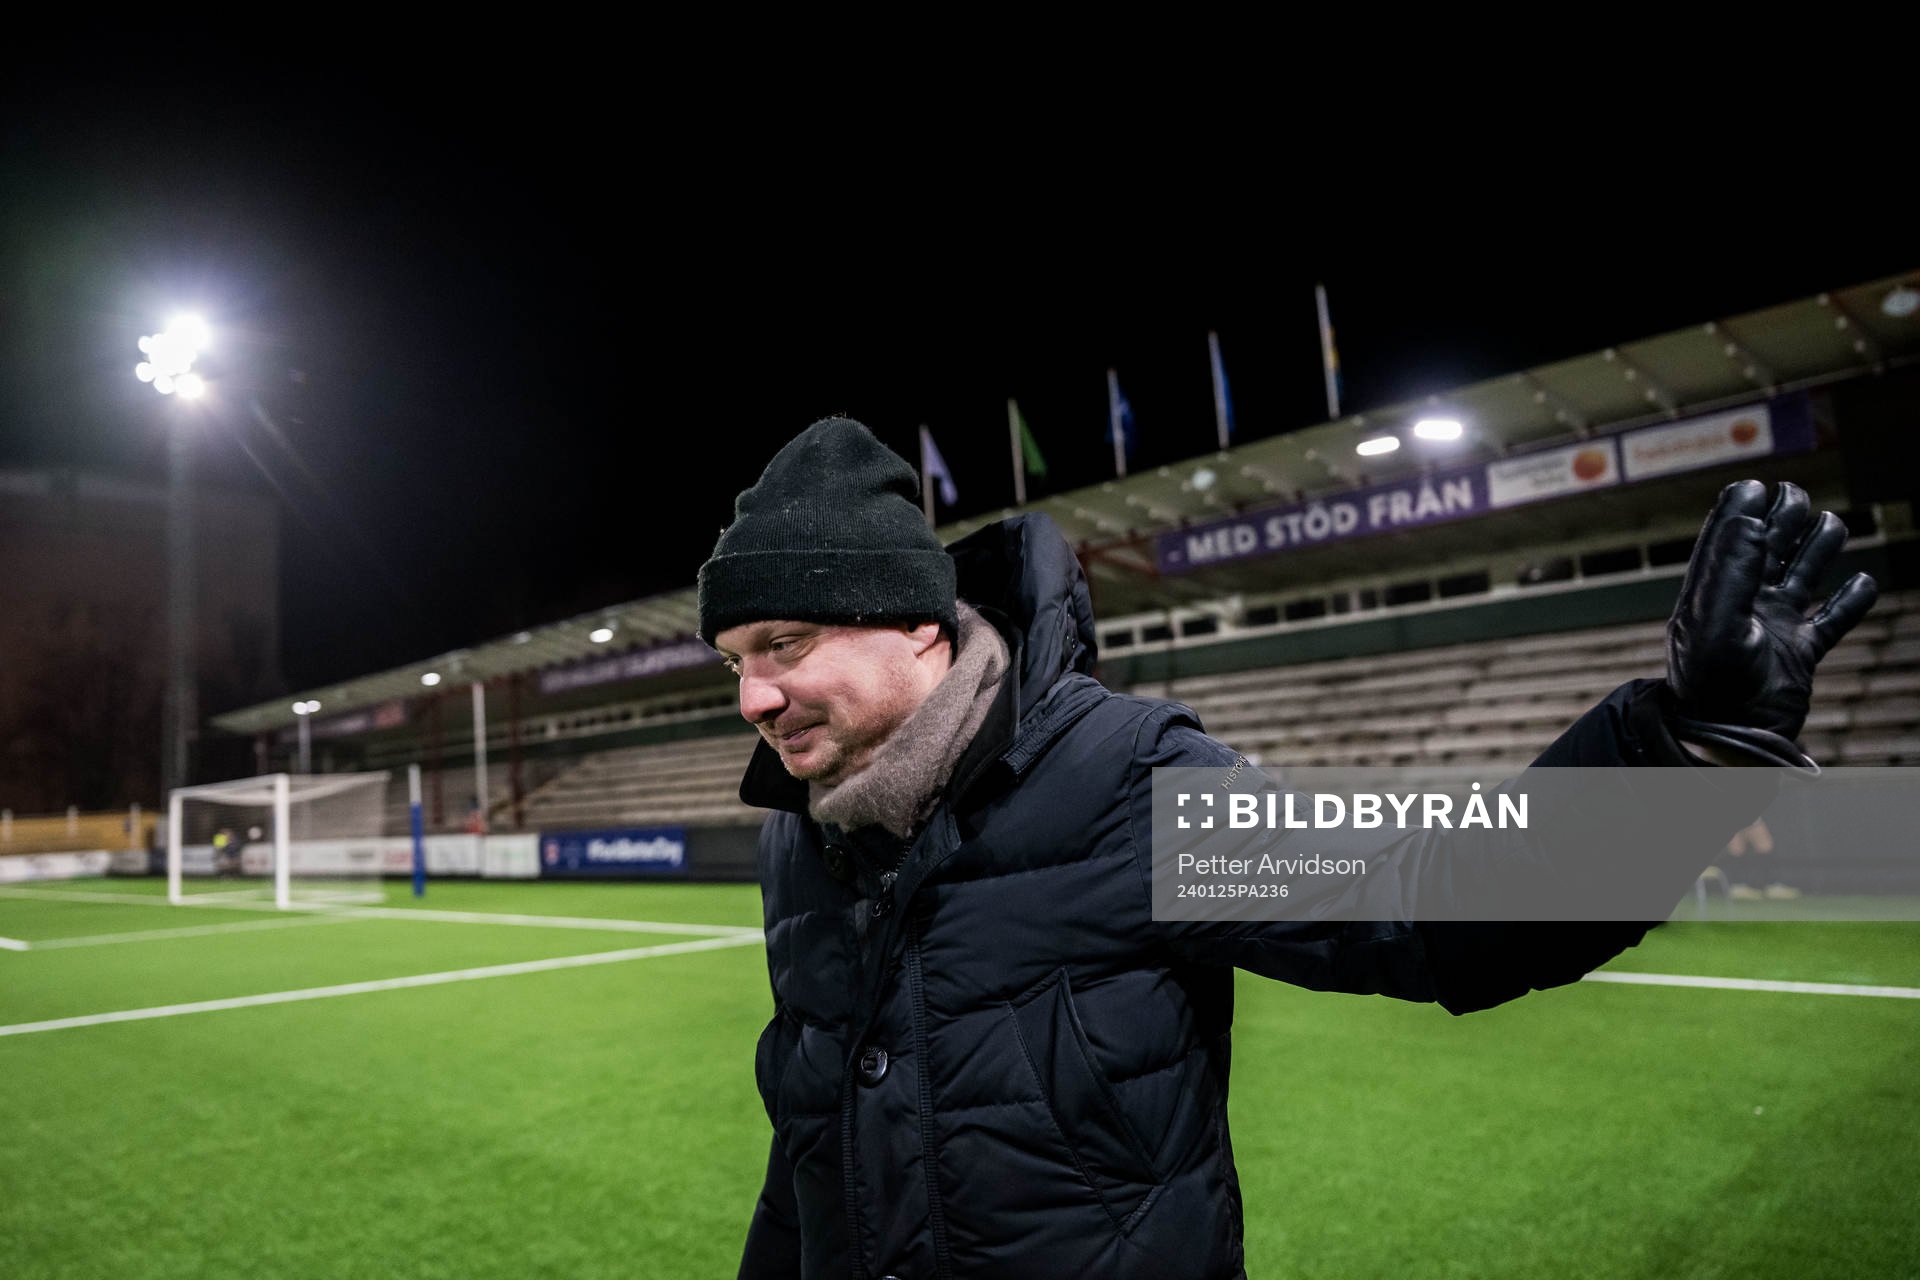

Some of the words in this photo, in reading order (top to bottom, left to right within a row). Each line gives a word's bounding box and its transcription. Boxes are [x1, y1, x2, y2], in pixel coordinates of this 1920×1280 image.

[1186, 523, 1258, 565] MED
[1265, 502, 1359, 549] STÖD
[1367, 478, 1474, 528] FRÅN
